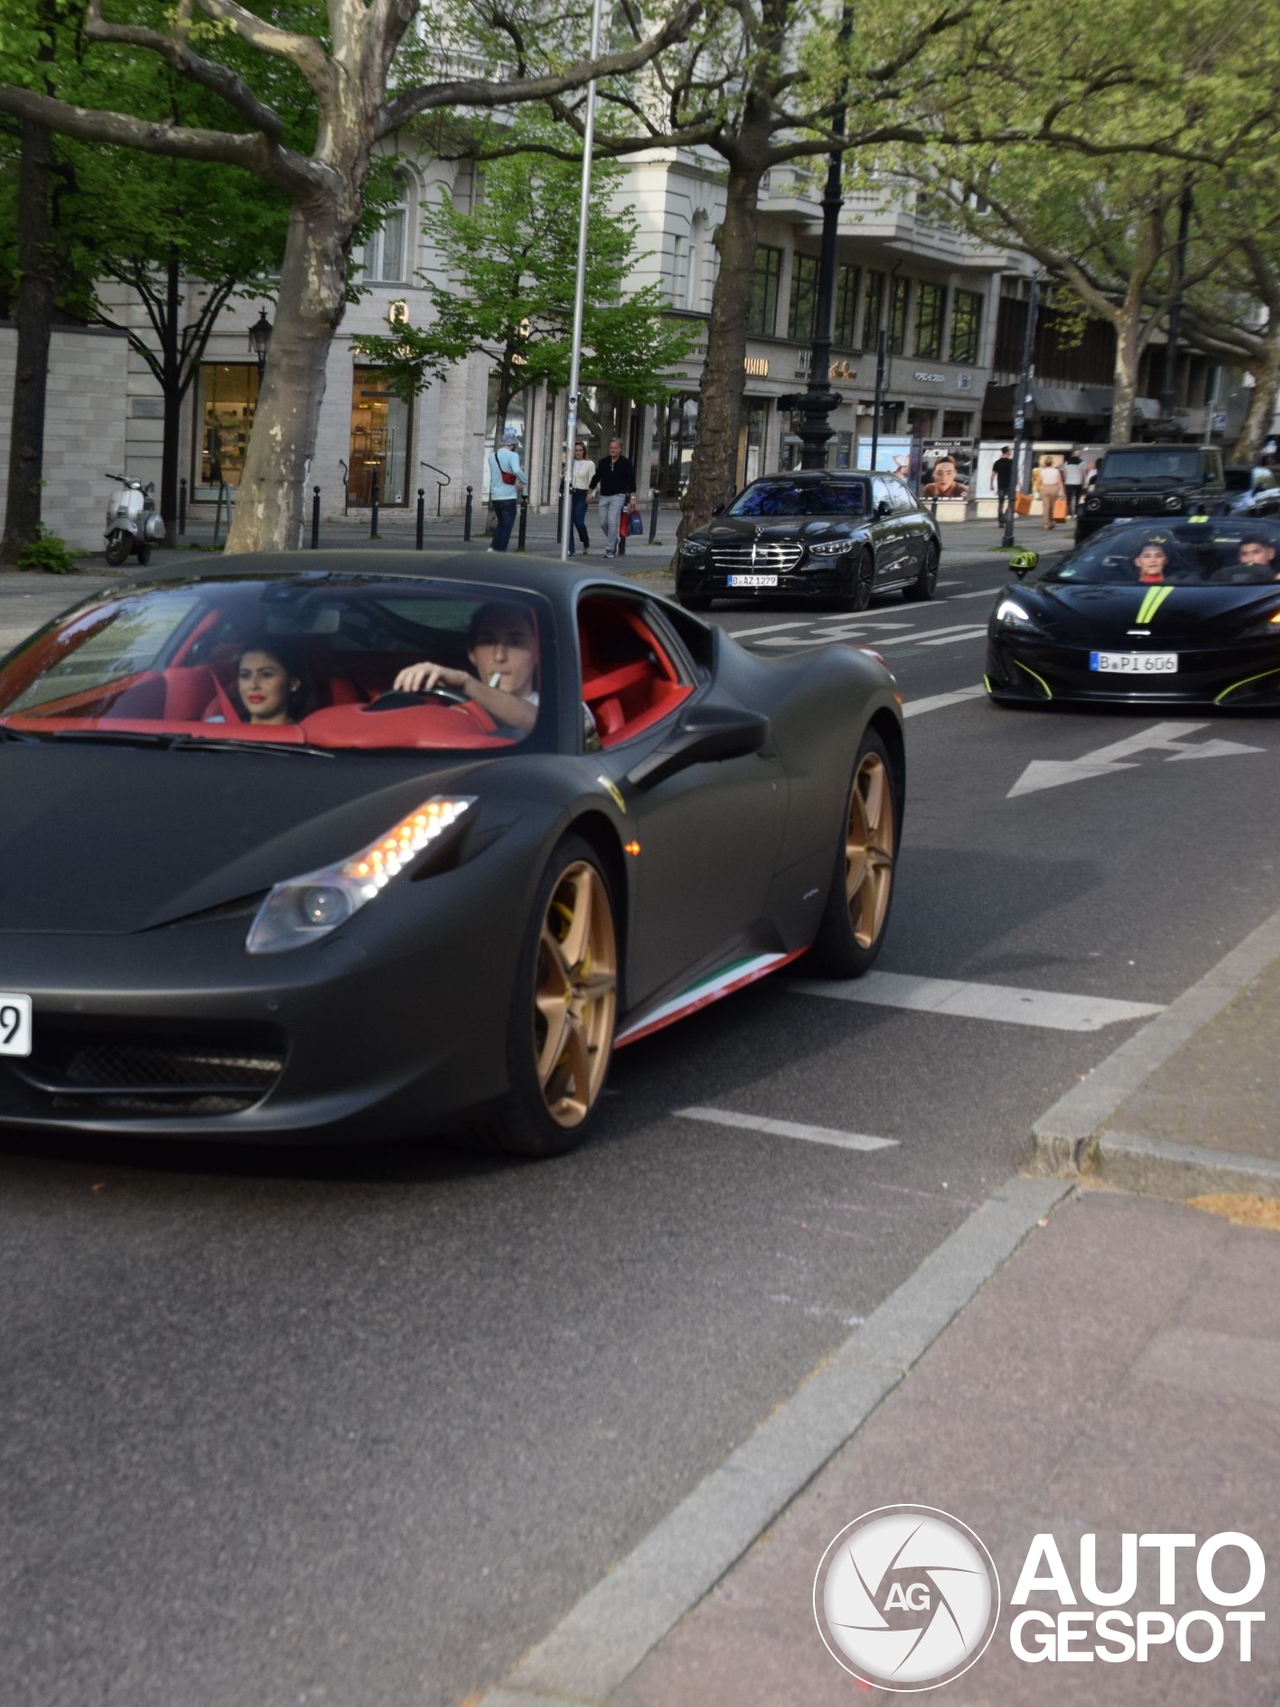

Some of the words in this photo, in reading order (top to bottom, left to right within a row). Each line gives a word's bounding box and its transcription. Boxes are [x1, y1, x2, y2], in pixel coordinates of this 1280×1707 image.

[743, 577, 754, 585] AZ
[756, 577, 776, 585] 1279
[1100, 656, 1109, 669] B
[1121, 657, 1139, 671] PI
[1144, 657, 1175, 671] 606
